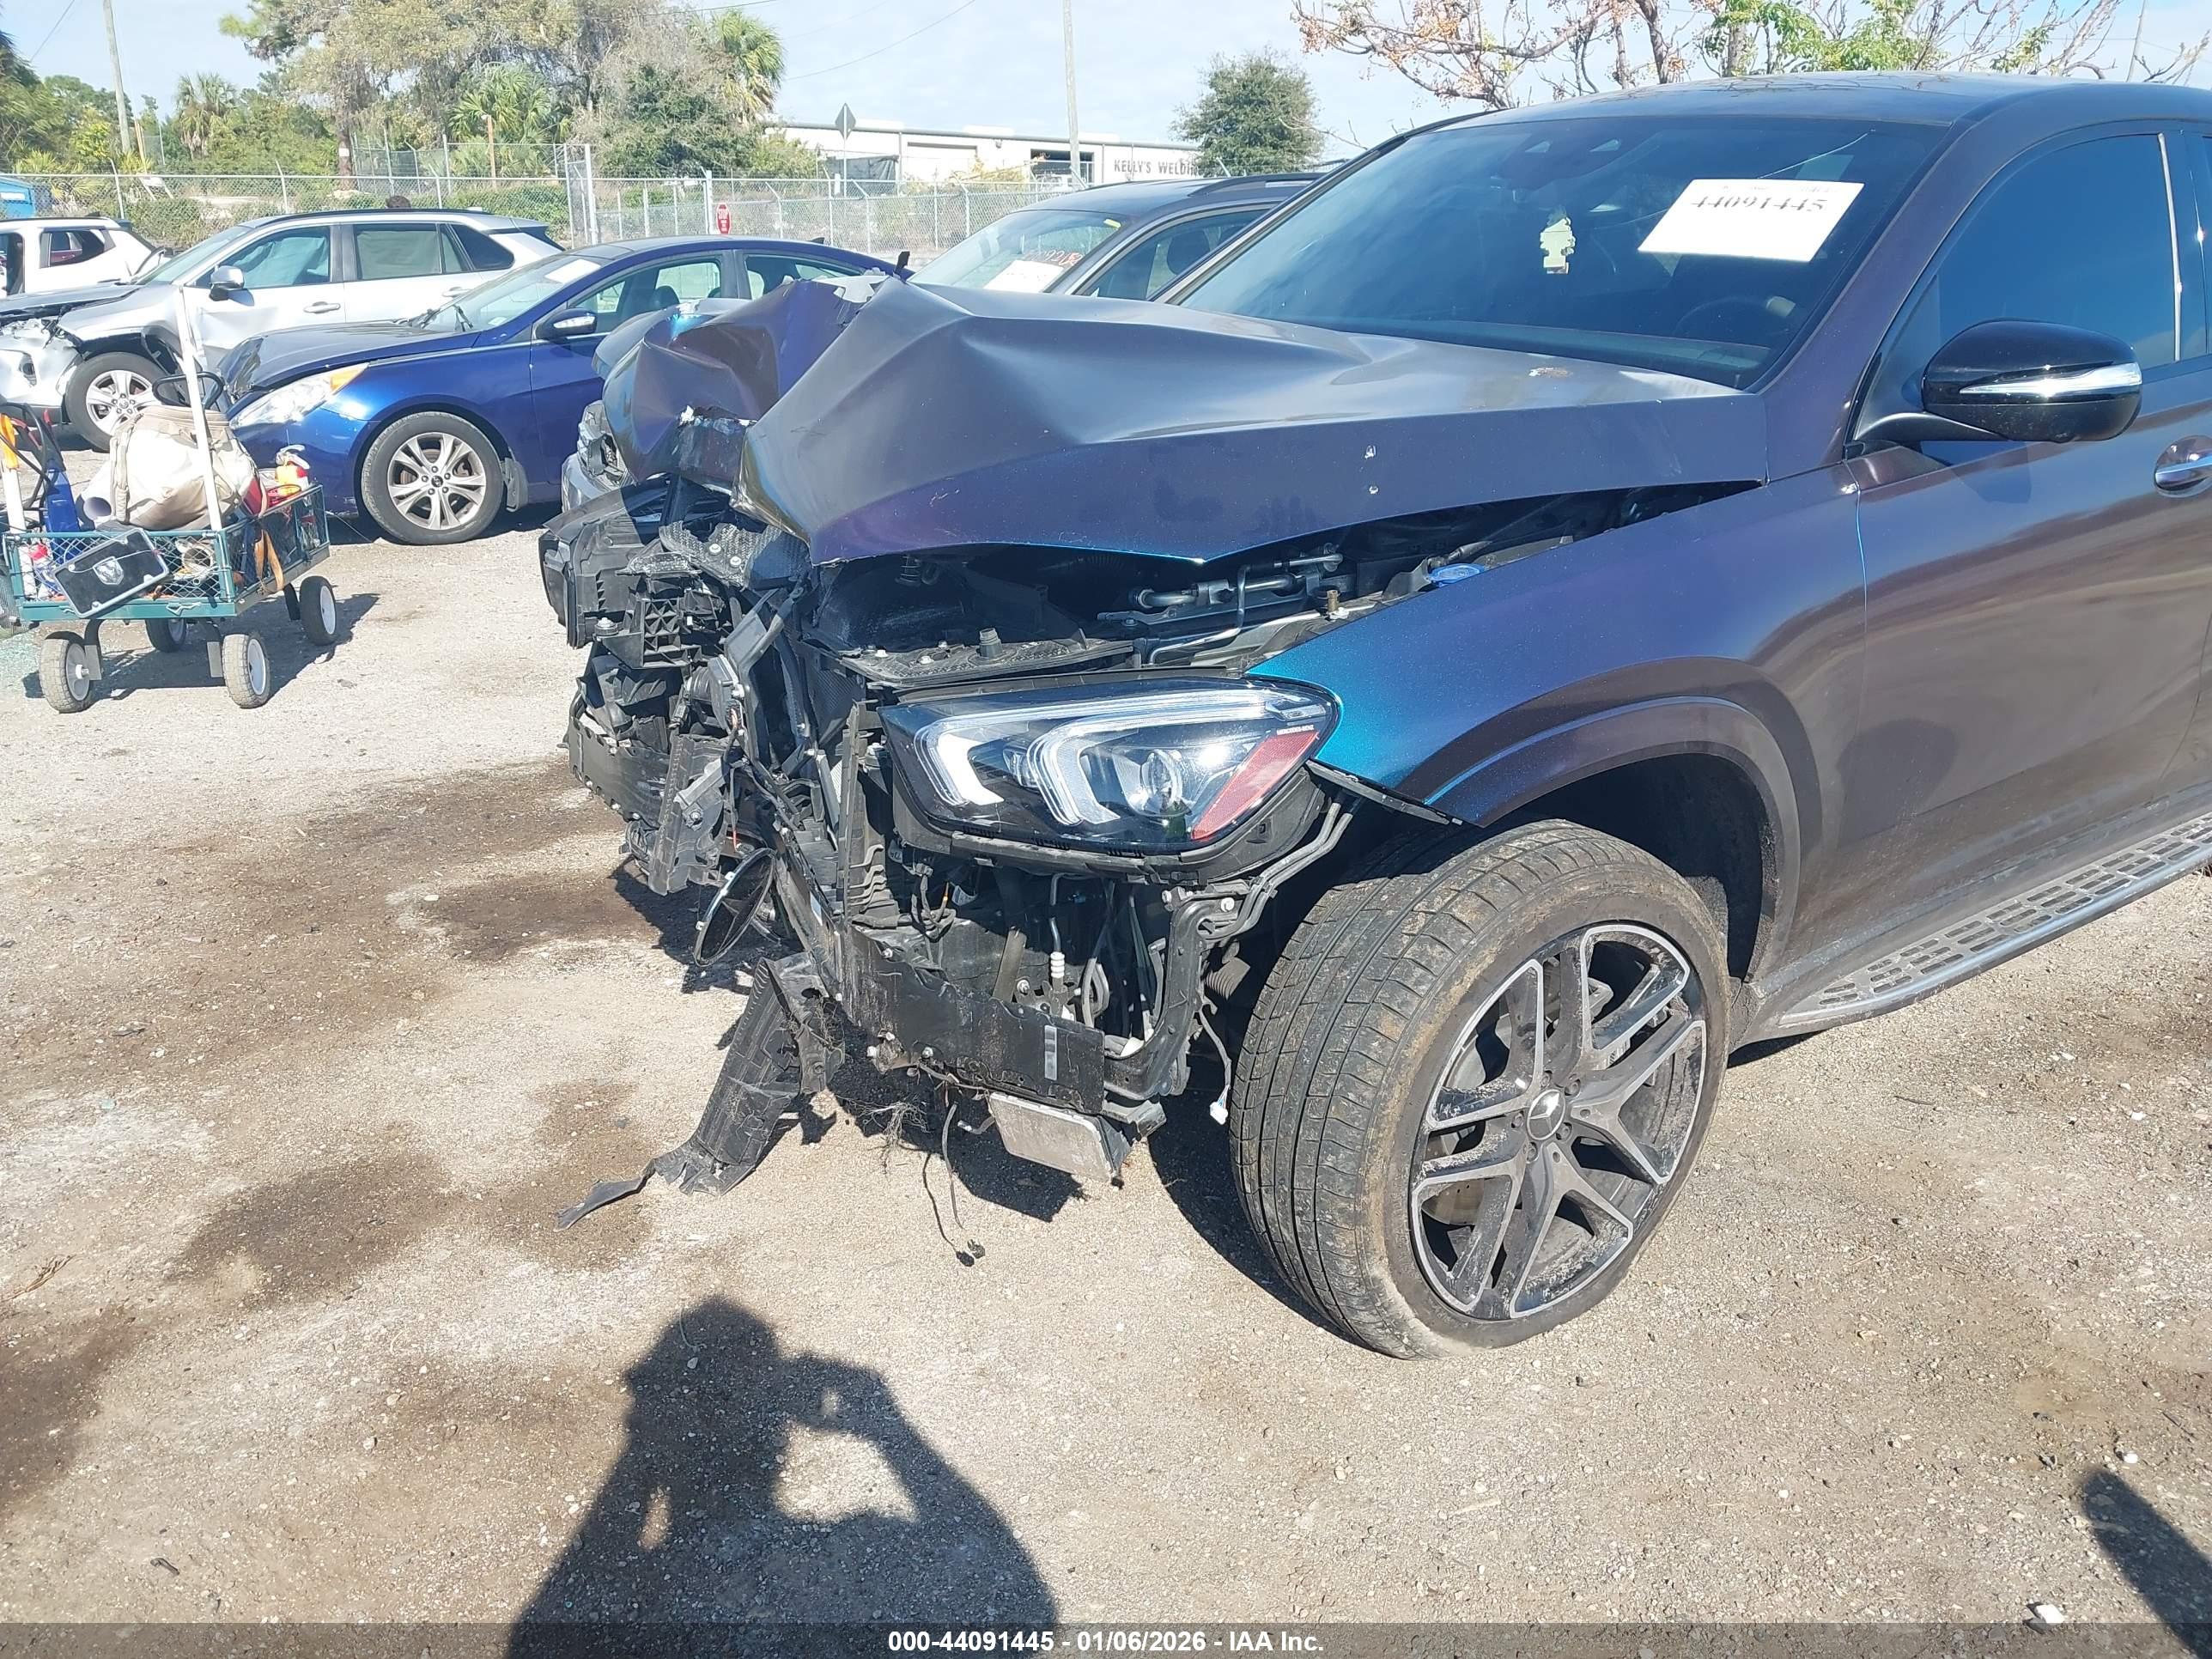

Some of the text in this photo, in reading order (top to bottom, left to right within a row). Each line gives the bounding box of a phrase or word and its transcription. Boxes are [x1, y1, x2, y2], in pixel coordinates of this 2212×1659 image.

[1114, 159, 1152, 173] KELLY'S
[1691, 195, 1828, 212] 44091445
[718, 208, 729, 220] STOP
